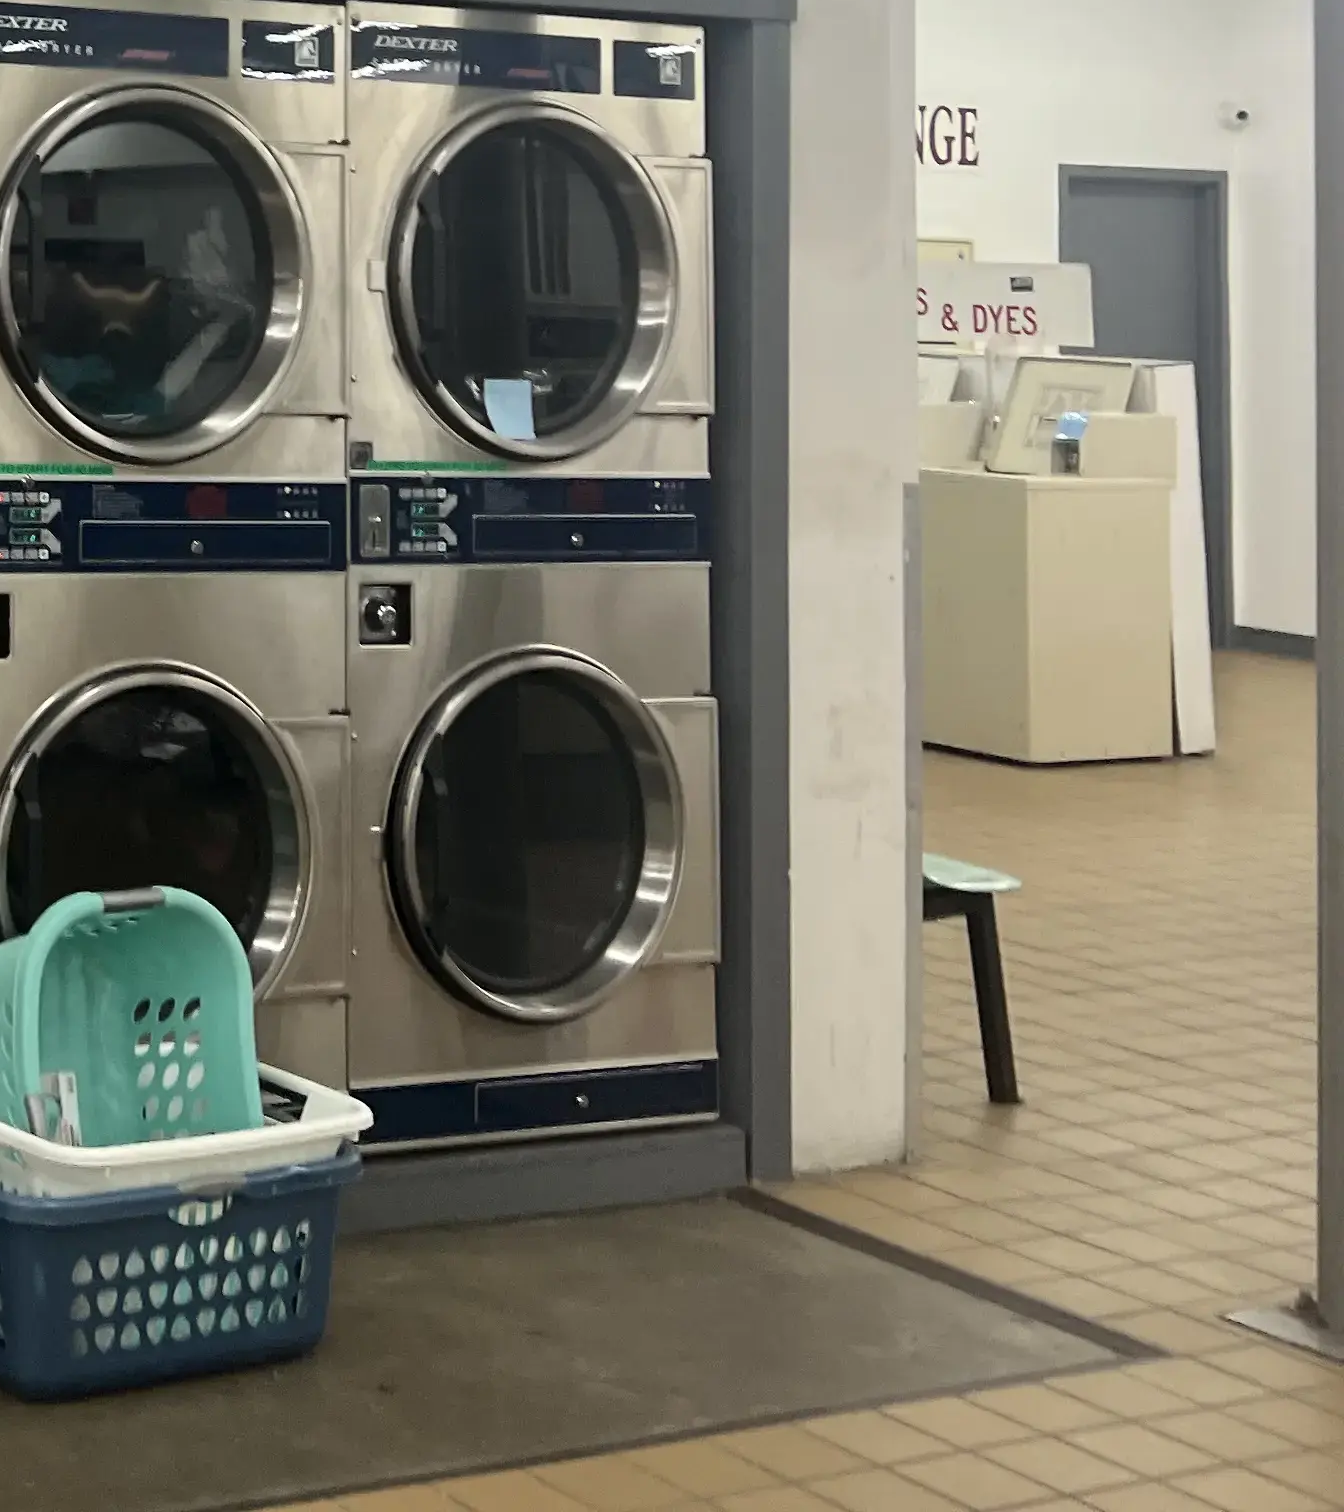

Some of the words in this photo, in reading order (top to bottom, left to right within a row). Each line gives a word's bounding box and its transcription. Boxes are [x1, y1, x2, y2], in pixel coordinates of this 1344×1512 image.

[373, 34, 458, 53] DEXTER
[941, 303, 959, 332] &
[972, 304, 1038, 336] DYES
